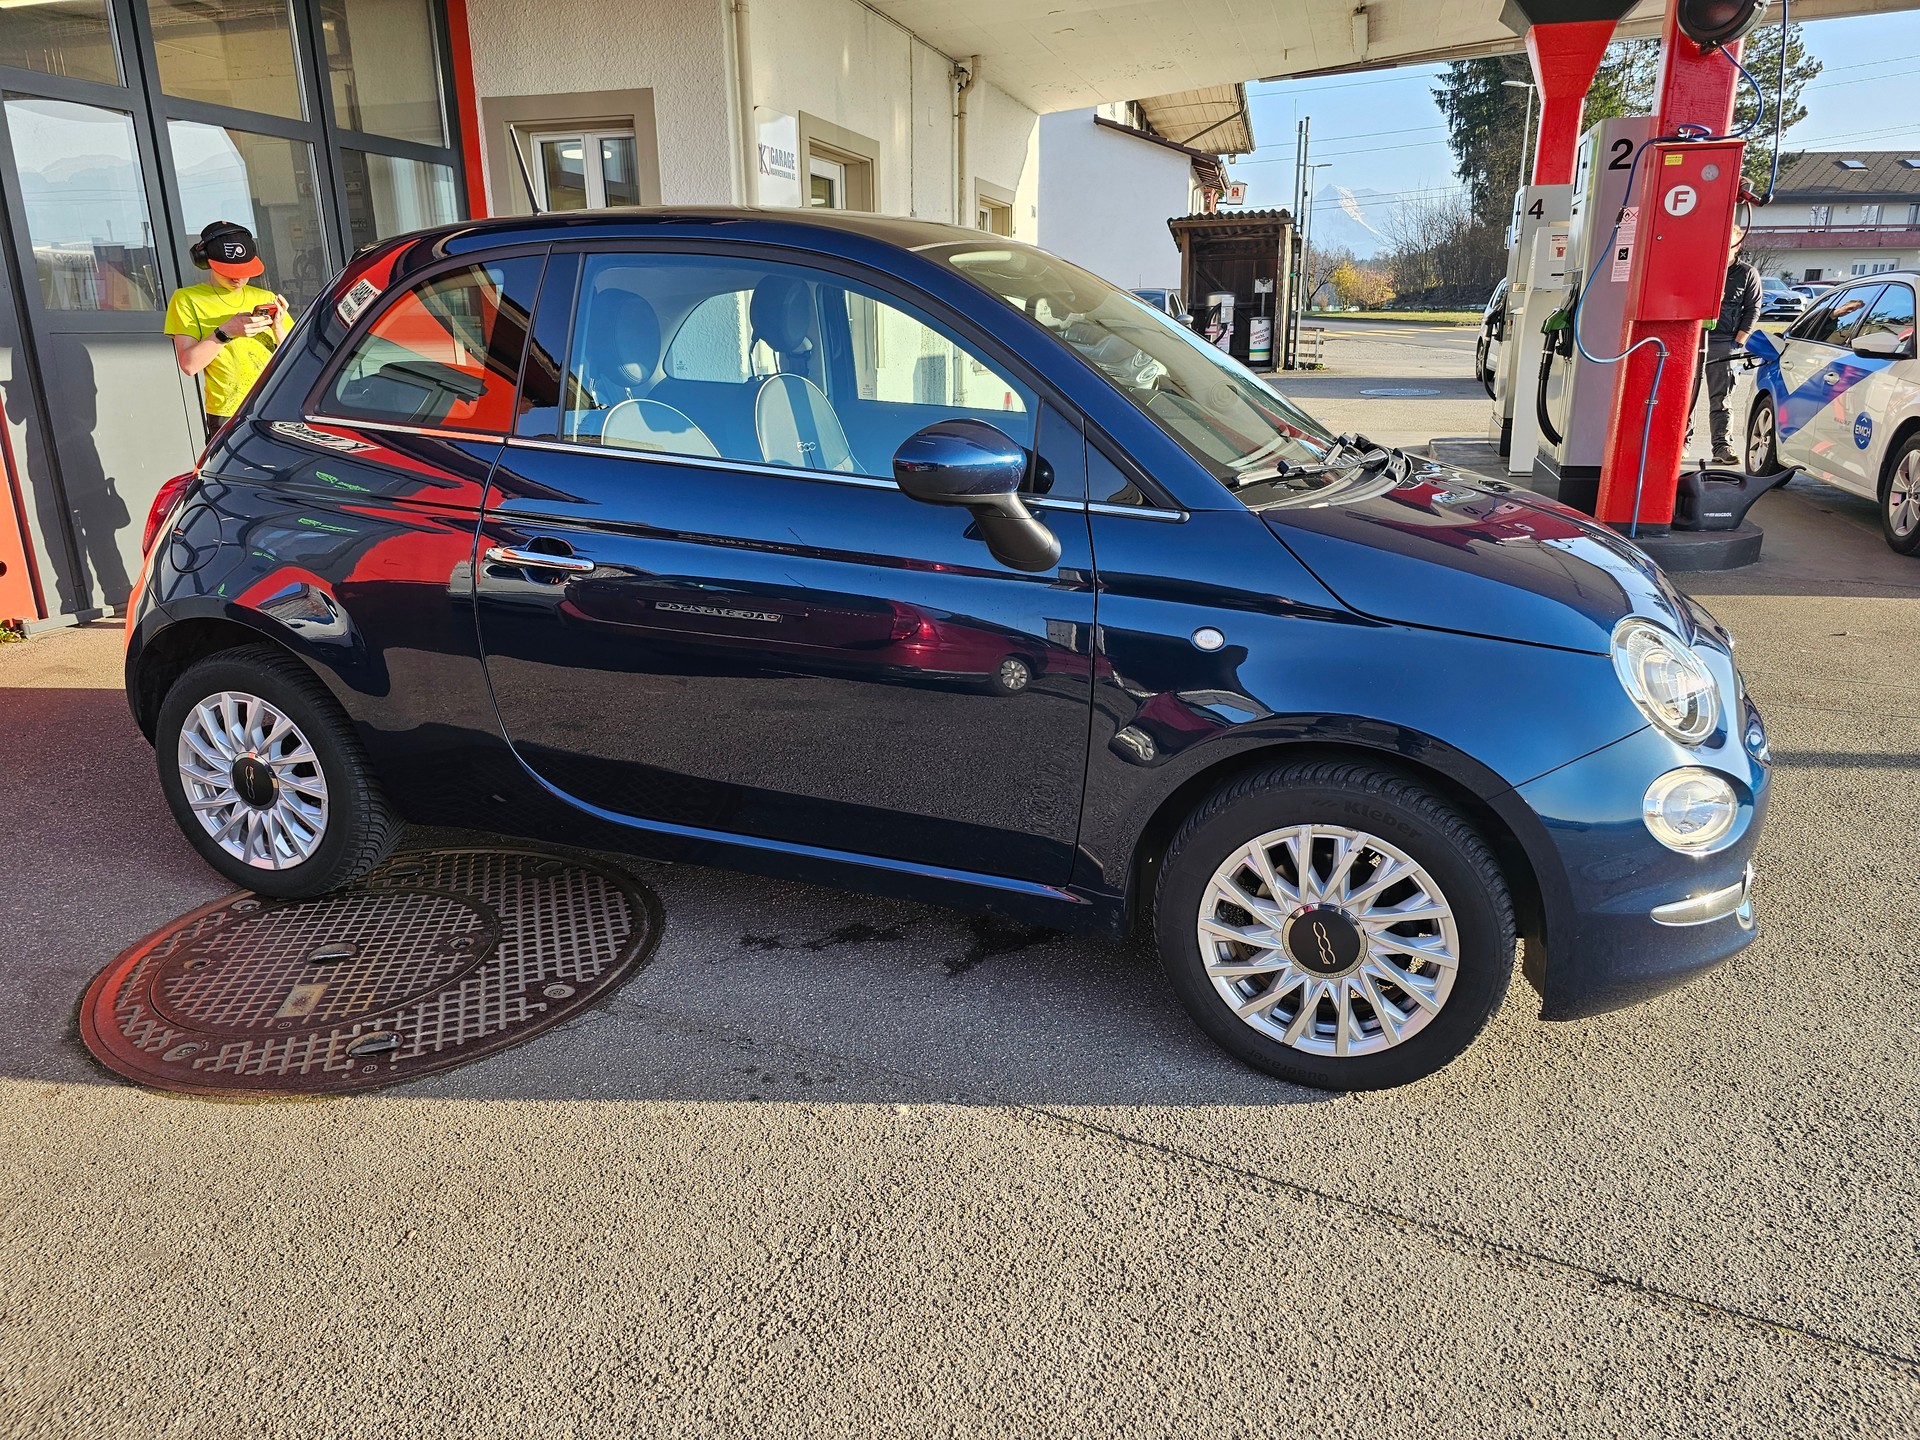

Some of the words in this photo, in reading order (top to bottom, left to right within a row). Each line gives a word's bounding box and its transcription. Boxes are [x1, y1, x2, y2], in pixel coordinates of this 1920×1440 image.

[770, 147, 795, 170] GARAGE
[1608, 138, 1634, 170] 2
[1528, 198, 1544, 219] 4
[1671, 190, 1690, 211] F
[1855, 424, 1871, 438] EMCH
[797, 441, 817, 453] 500
[1343, 801, 1423, 840] Kleber
